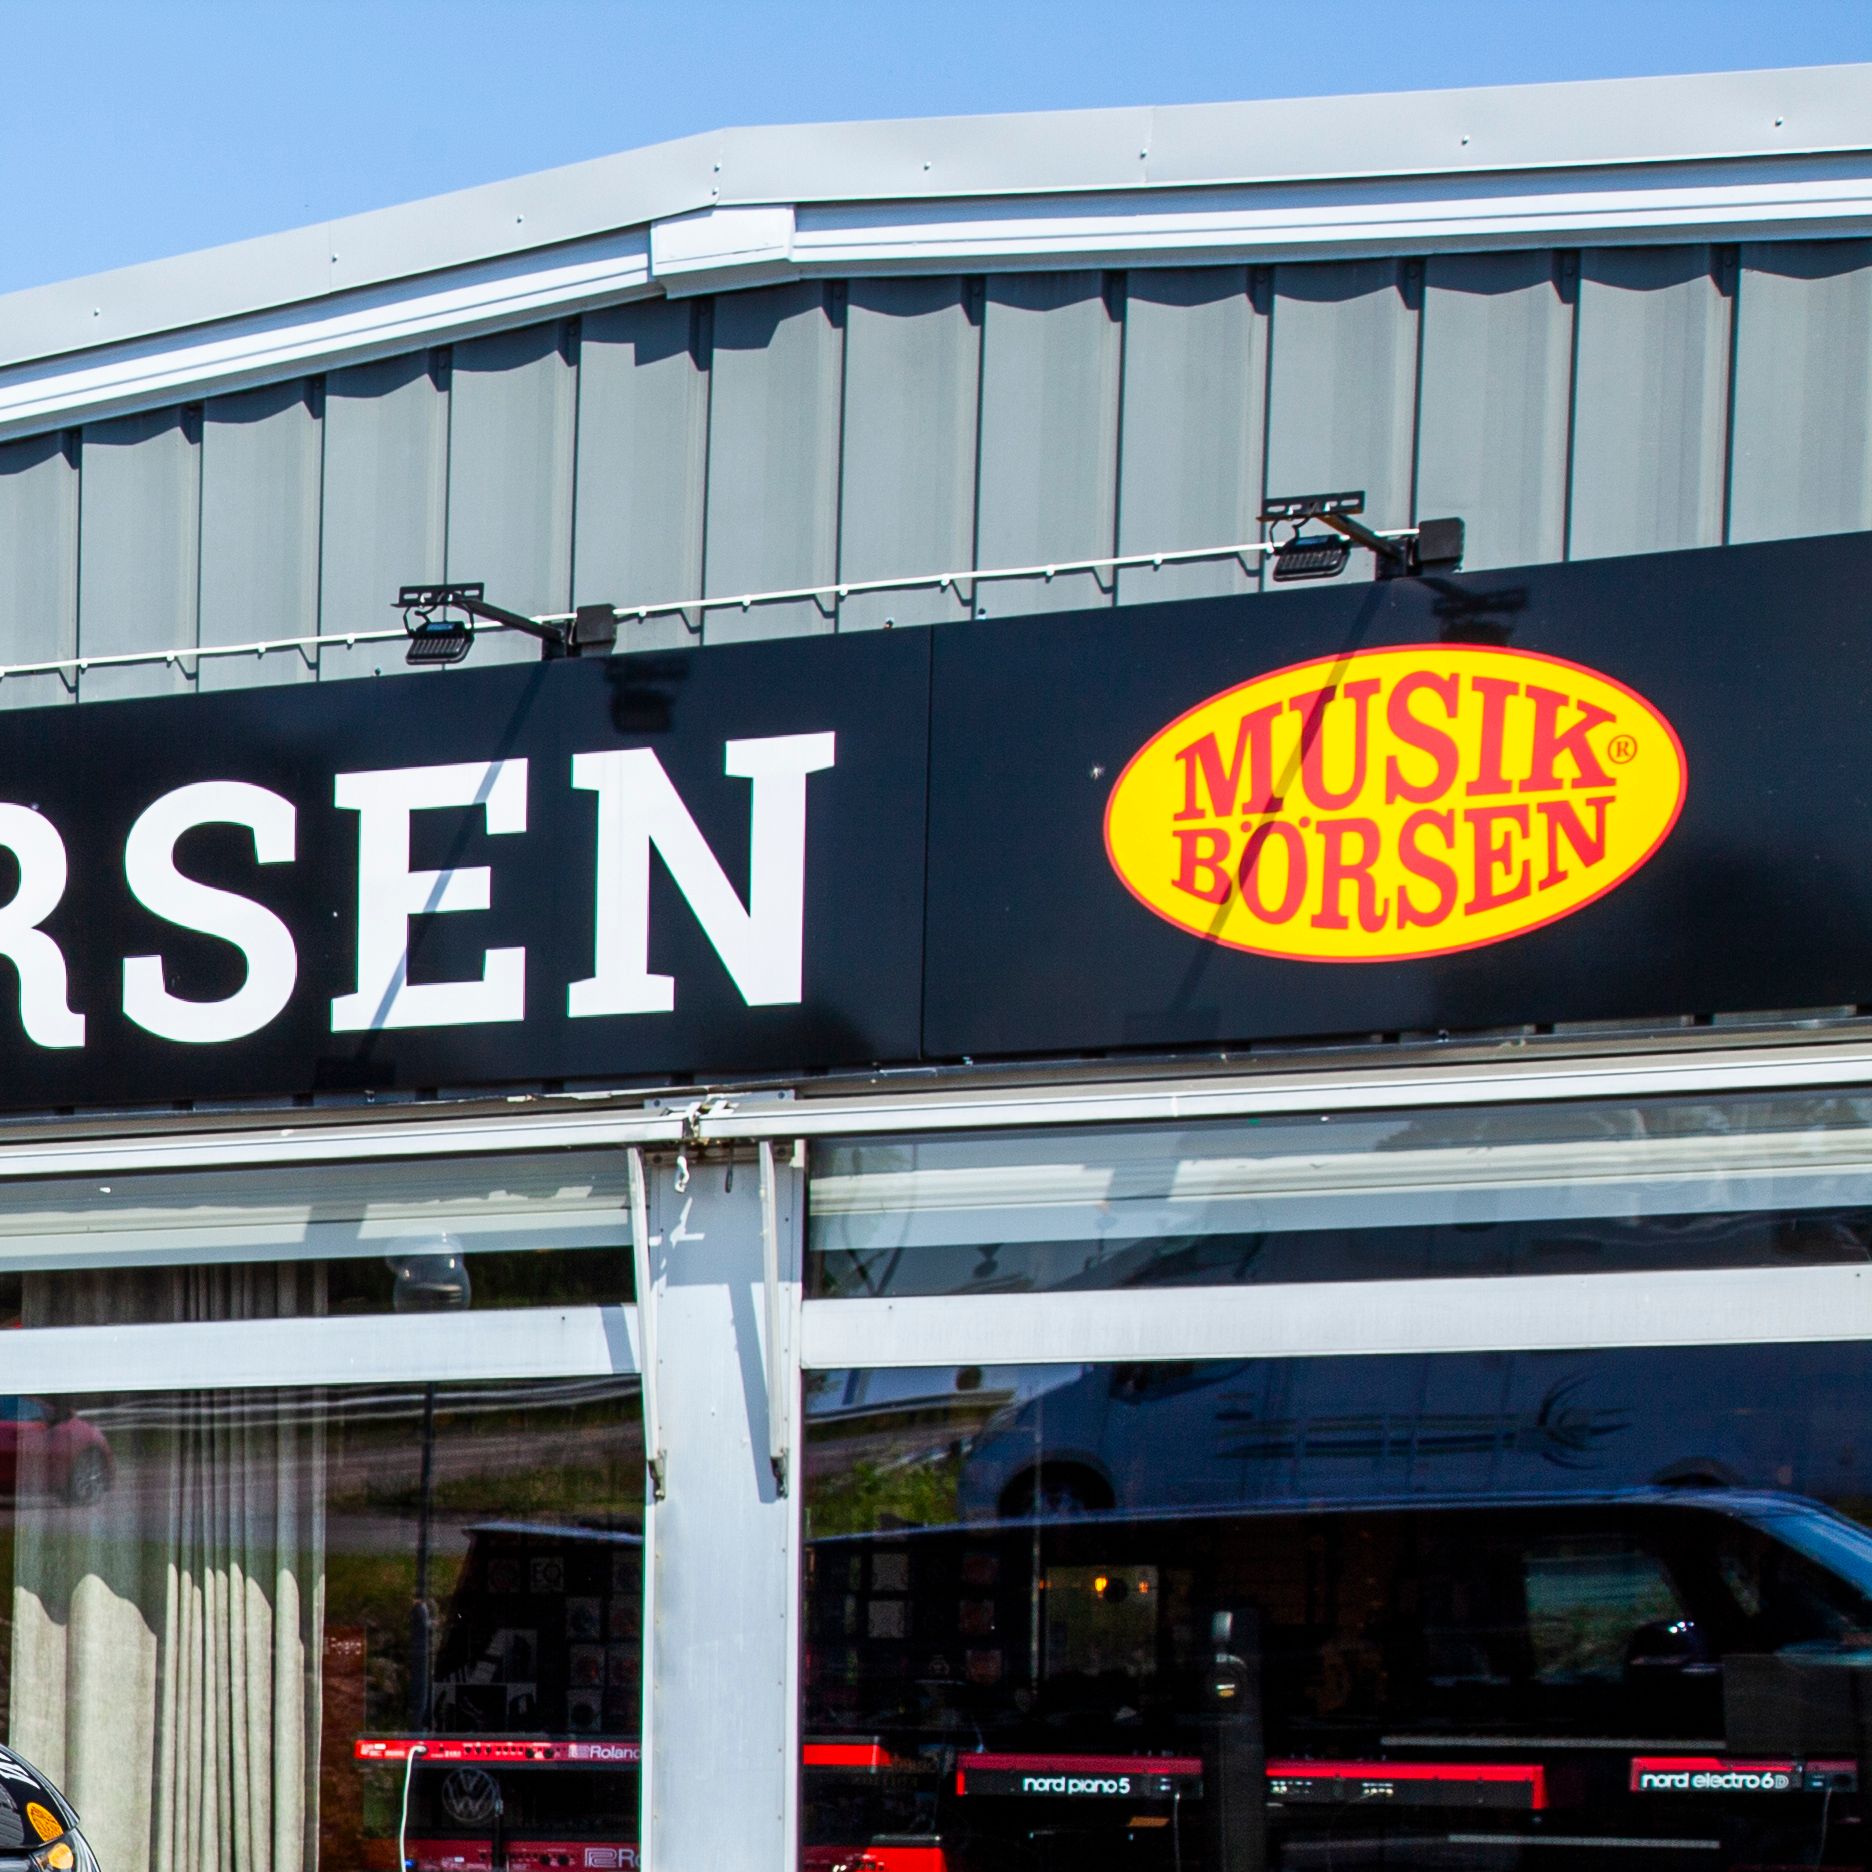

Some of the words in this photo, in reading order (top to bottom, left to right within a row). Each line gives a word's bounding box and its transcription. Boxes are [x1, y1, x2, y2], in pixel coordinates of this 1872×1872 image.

[1171, 795, 1616, 932] BÖRSEN
[1023, 1777, 1066, 1793] nord
[1641, 1771, 1689, 1789] nord
